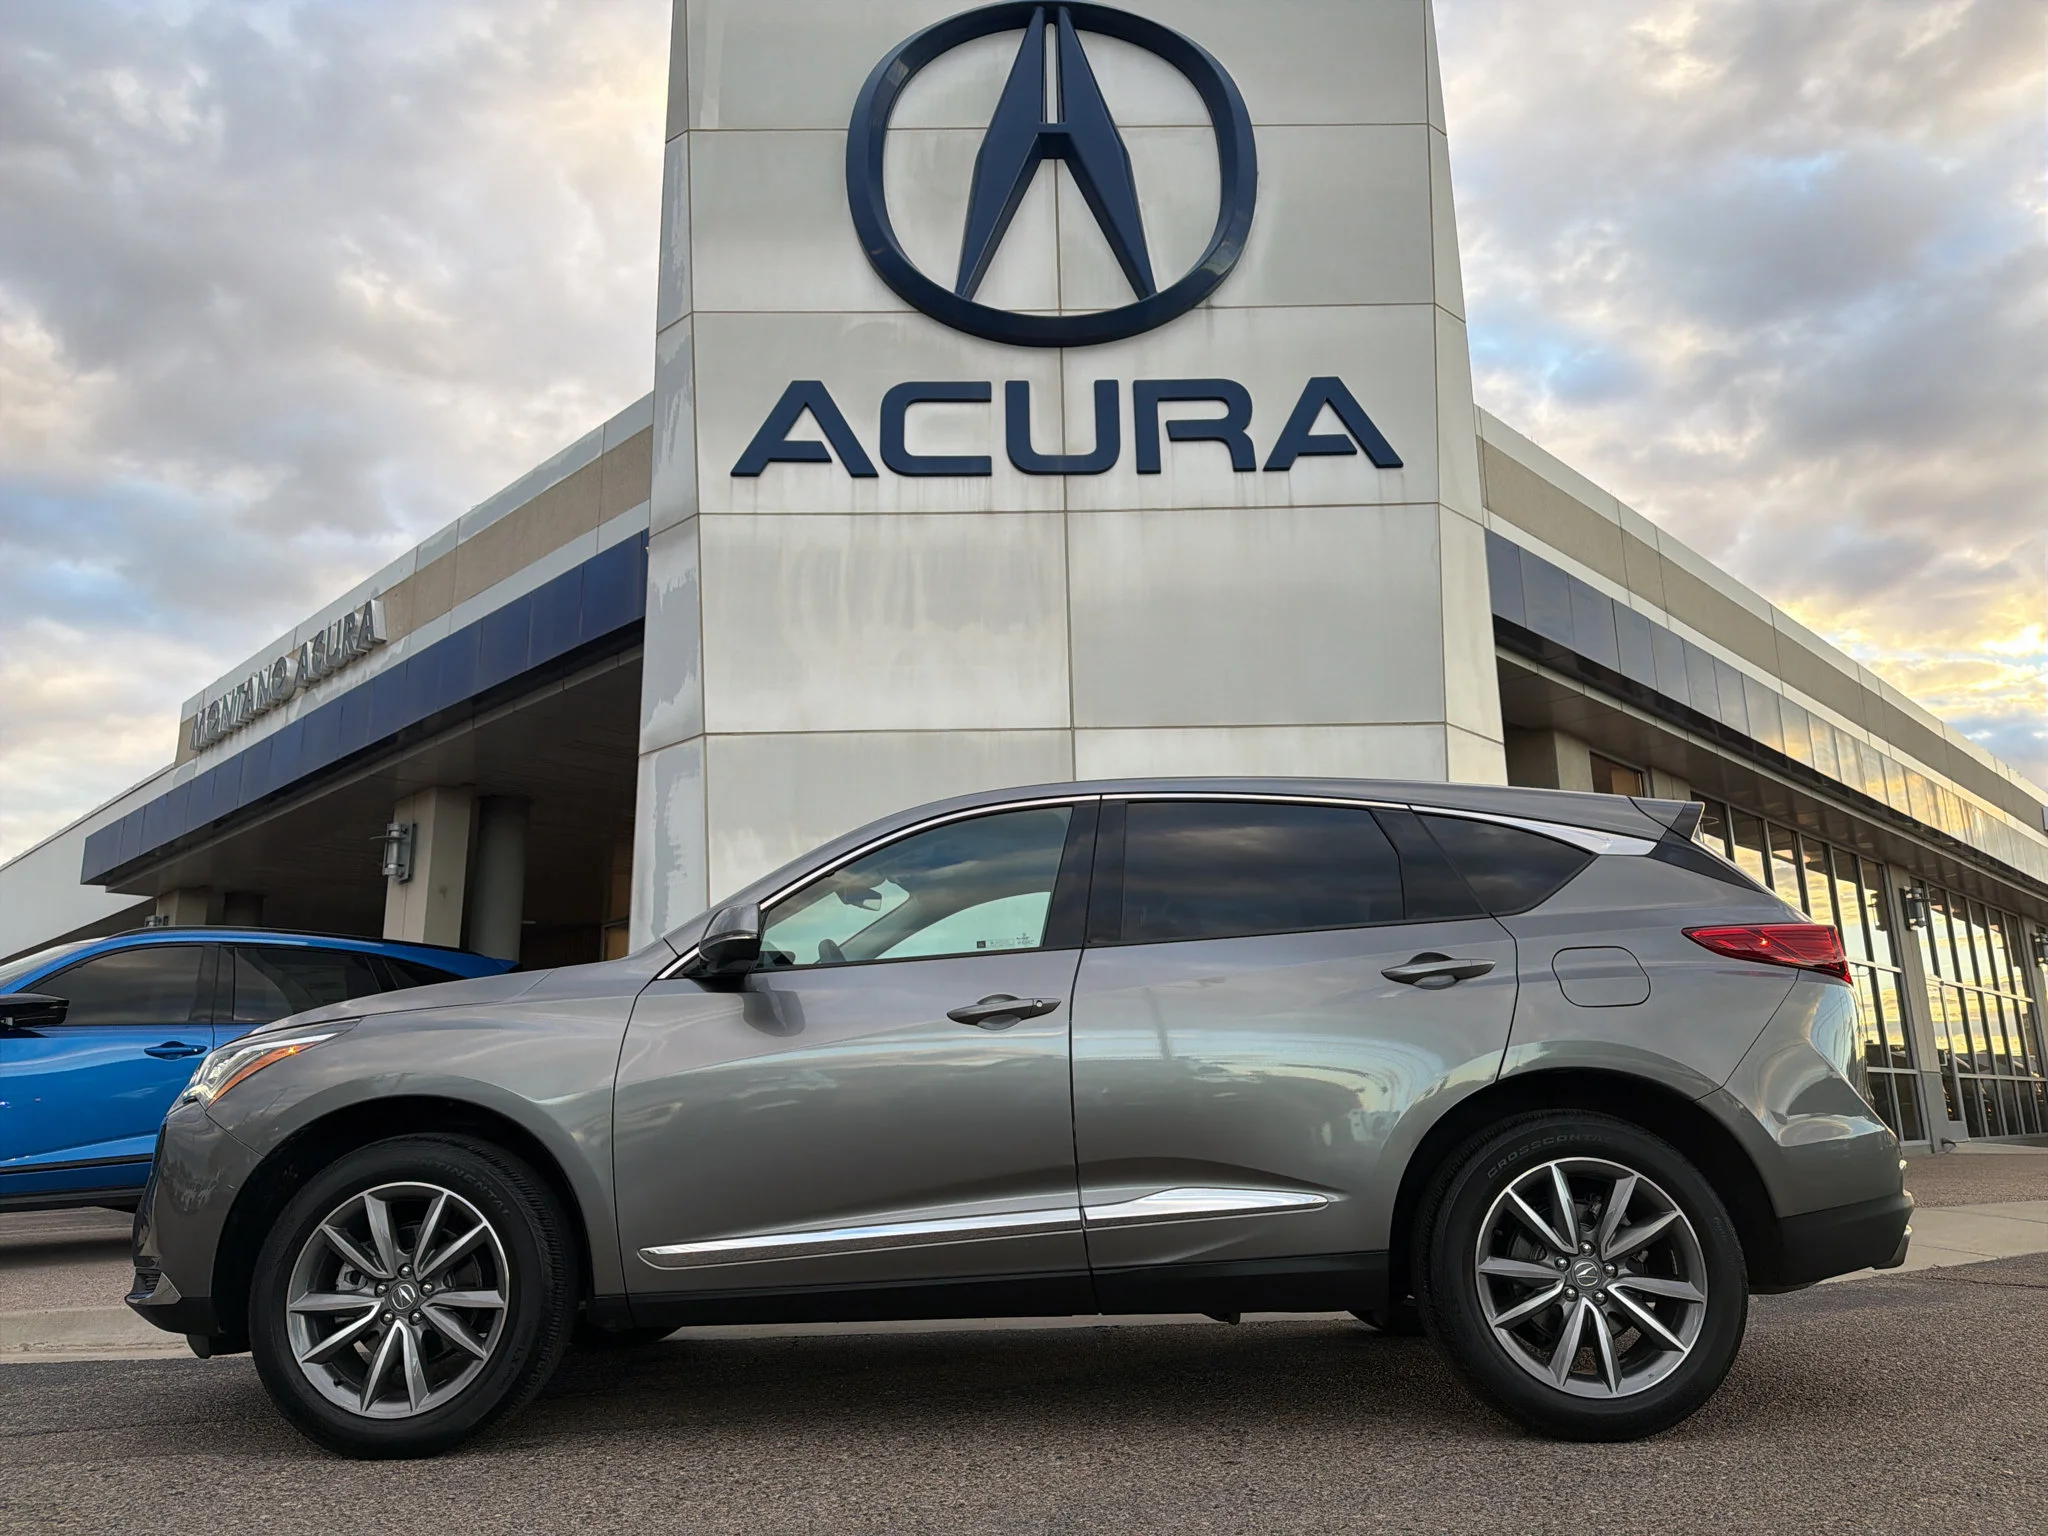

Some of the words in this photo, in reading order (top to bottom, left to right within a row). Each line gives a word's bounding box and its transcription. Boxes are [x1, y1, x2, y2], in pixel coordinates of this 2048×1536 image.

[731, 377, 1403, 478] ACURA
[190, 656, 294, 750] MONTANO
[294, 600, 385, 688] ACURA
[1487, 1133, 1616, 1180] CROSSCONTAC
